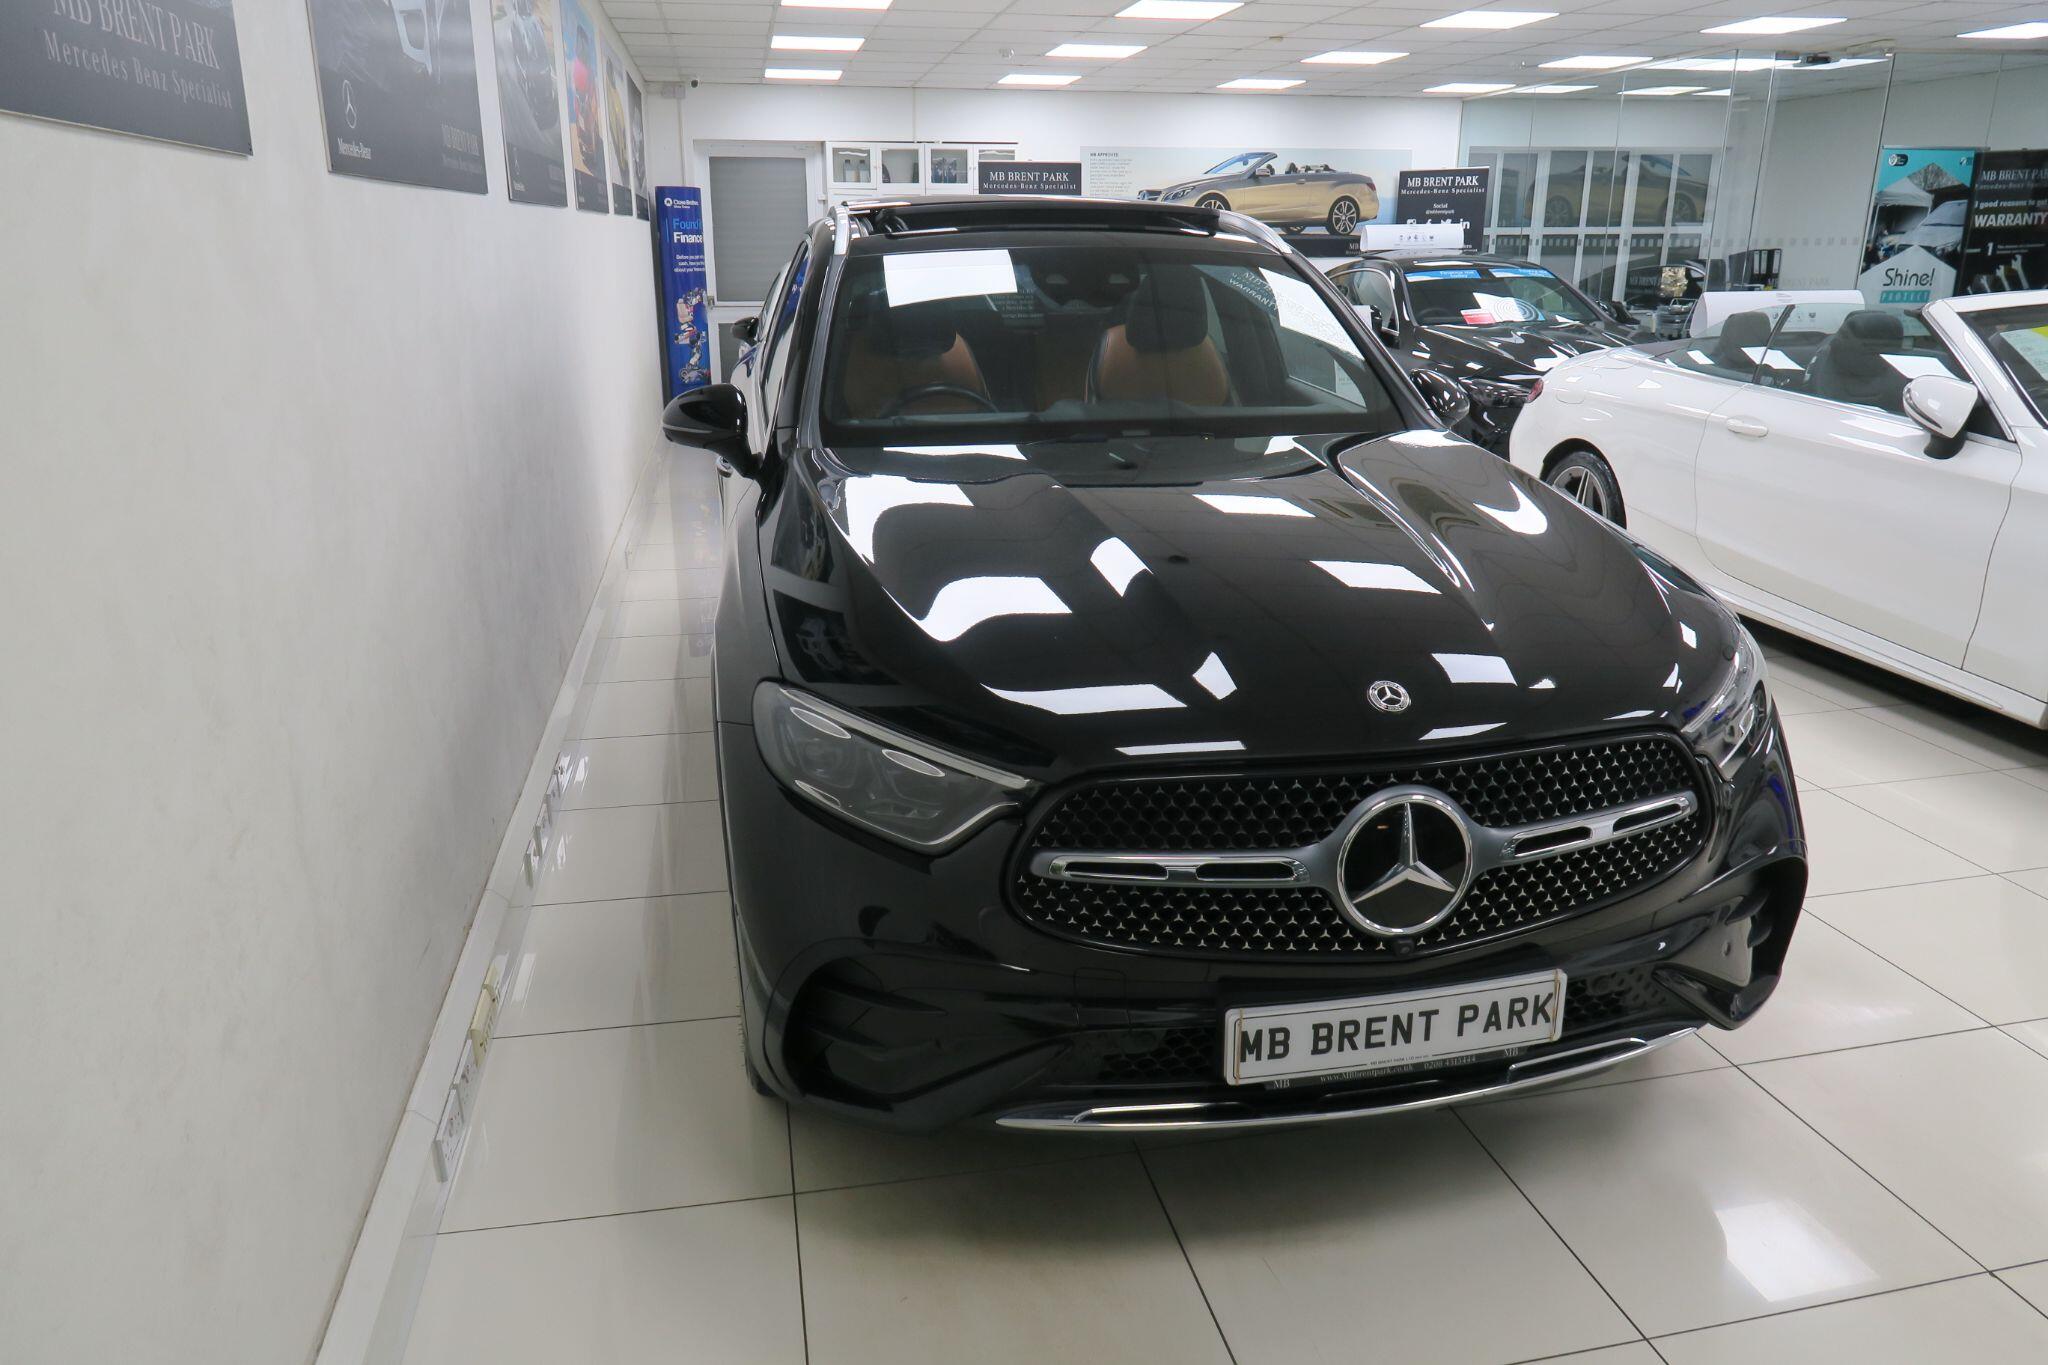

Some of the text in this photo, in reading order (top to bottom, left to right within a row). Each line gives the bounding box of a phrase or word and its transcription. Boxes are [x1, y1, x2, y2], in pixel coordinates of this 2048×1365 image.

[98, 0, 168, 52] BRENT
[168, 11, 222, 70] PARK
[43, 29, 233, 109] Mercedes Benz Specialist
[989, 171, 1069, 182] MB BRENT PARK
[1982, 171, 1997, 181] MB
[1998, 170, 2029, 180] BRENT
[1040, 182, 1076, 190] Specialist
[1407, 176, 1479, 188] MB BRENT PARK
[1452, 187, 1485, 195] Specialist
[1980, 200, 1998, 210] good
[1975, 212, 2048, 228] WARRANTY
[674, 232, 702, 244] Finance
[1882, 268, 1935, 288] Shine!
[1240, 992, 1554, 1062] MB BRENT PARK
[1504, 1047, 1519, 1057] MB
